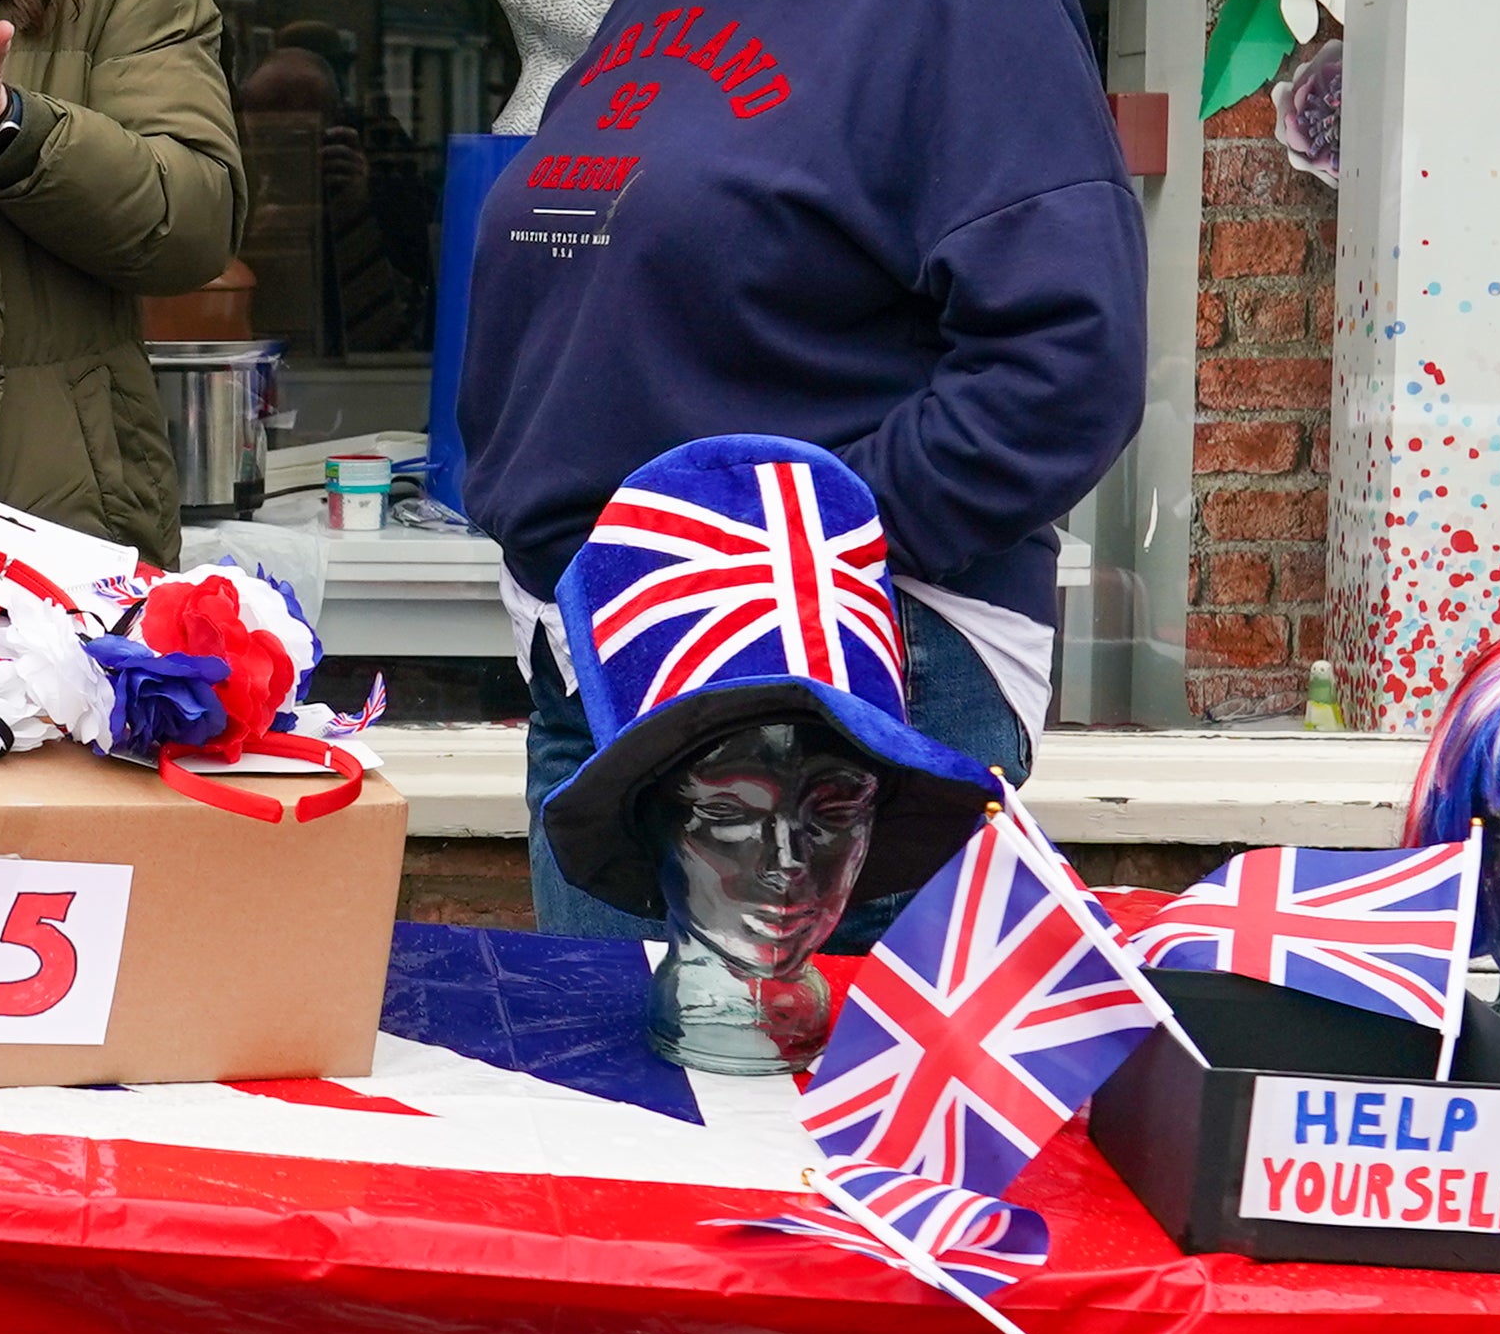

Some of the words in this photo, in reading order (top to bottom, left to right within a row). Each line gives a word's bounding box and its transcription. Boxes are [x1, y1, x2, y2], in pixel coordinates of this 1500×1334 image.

[597, 81, 661, 130] 92
[527, 155, 640, 191] OREGON
[510, 230, 548, 243] POSITIVE
[551, 232, 577, 244] STATE
[1294, 1090, 1478, 1153] HELP
